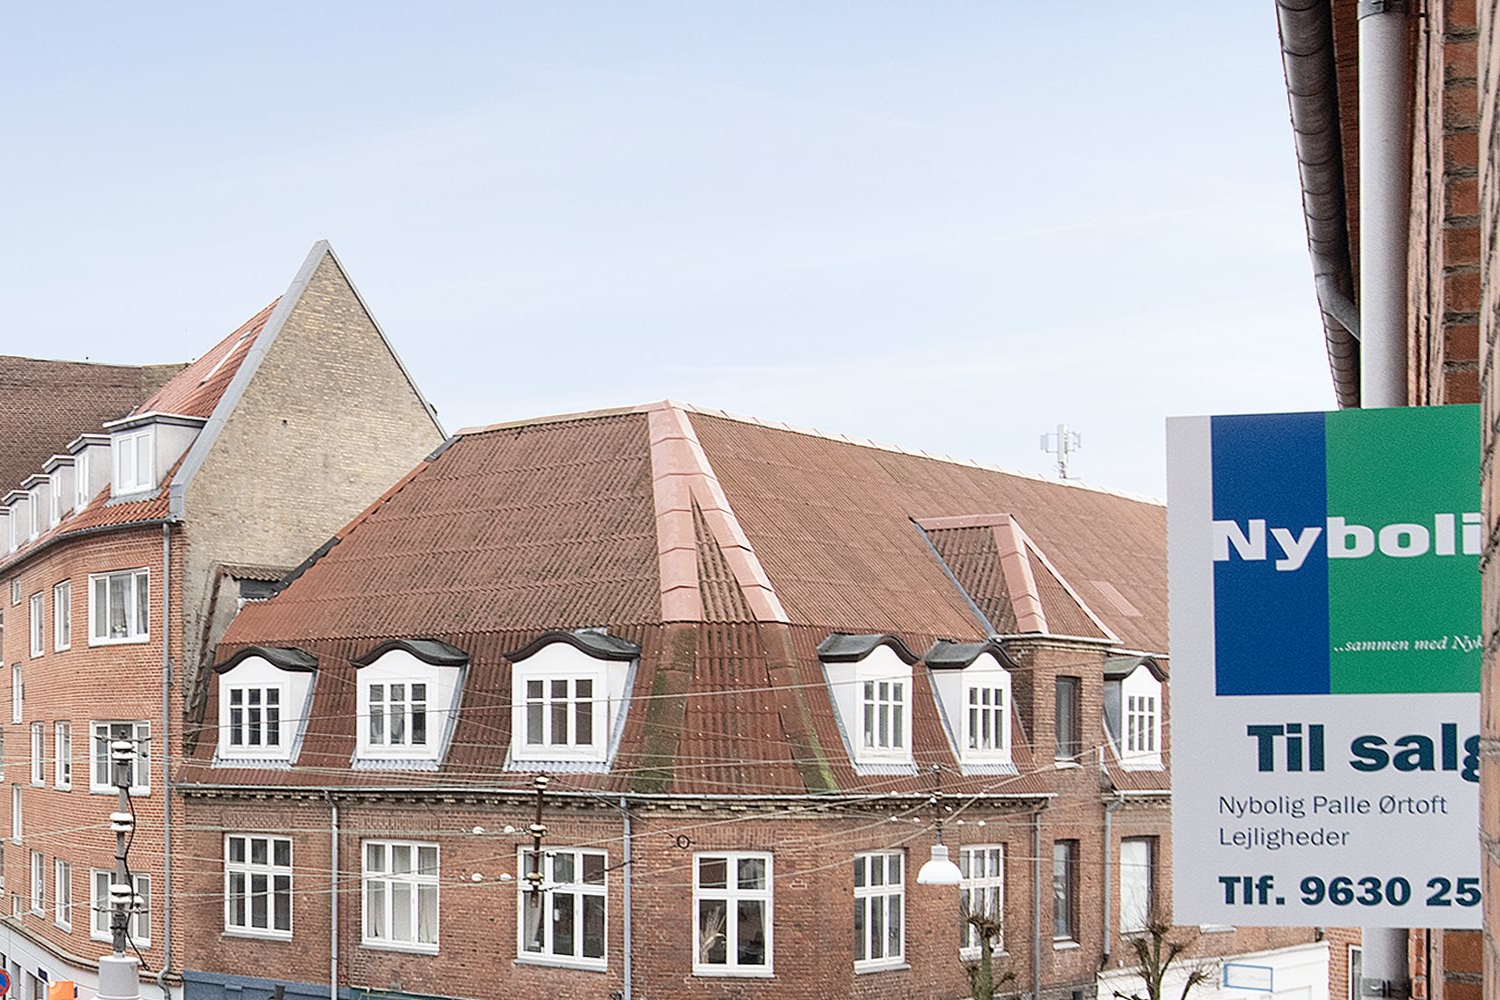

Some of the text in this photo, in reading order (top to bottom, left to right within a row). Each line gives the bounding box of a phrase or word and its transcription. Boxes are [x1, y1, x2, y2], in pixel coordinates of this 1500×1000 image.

[1213, 513, 1481, 571] Nyboli
[1414, 635, 1448, 650] med
[1247, 723, 1325, 772] Til
[1219, 795, 1448, 818] Nybolig Palle Ørtoft
[1219, 827, 1350, 850] Lejligheder
[1218, 875, 1482, 906] Tlf. 9630 25
